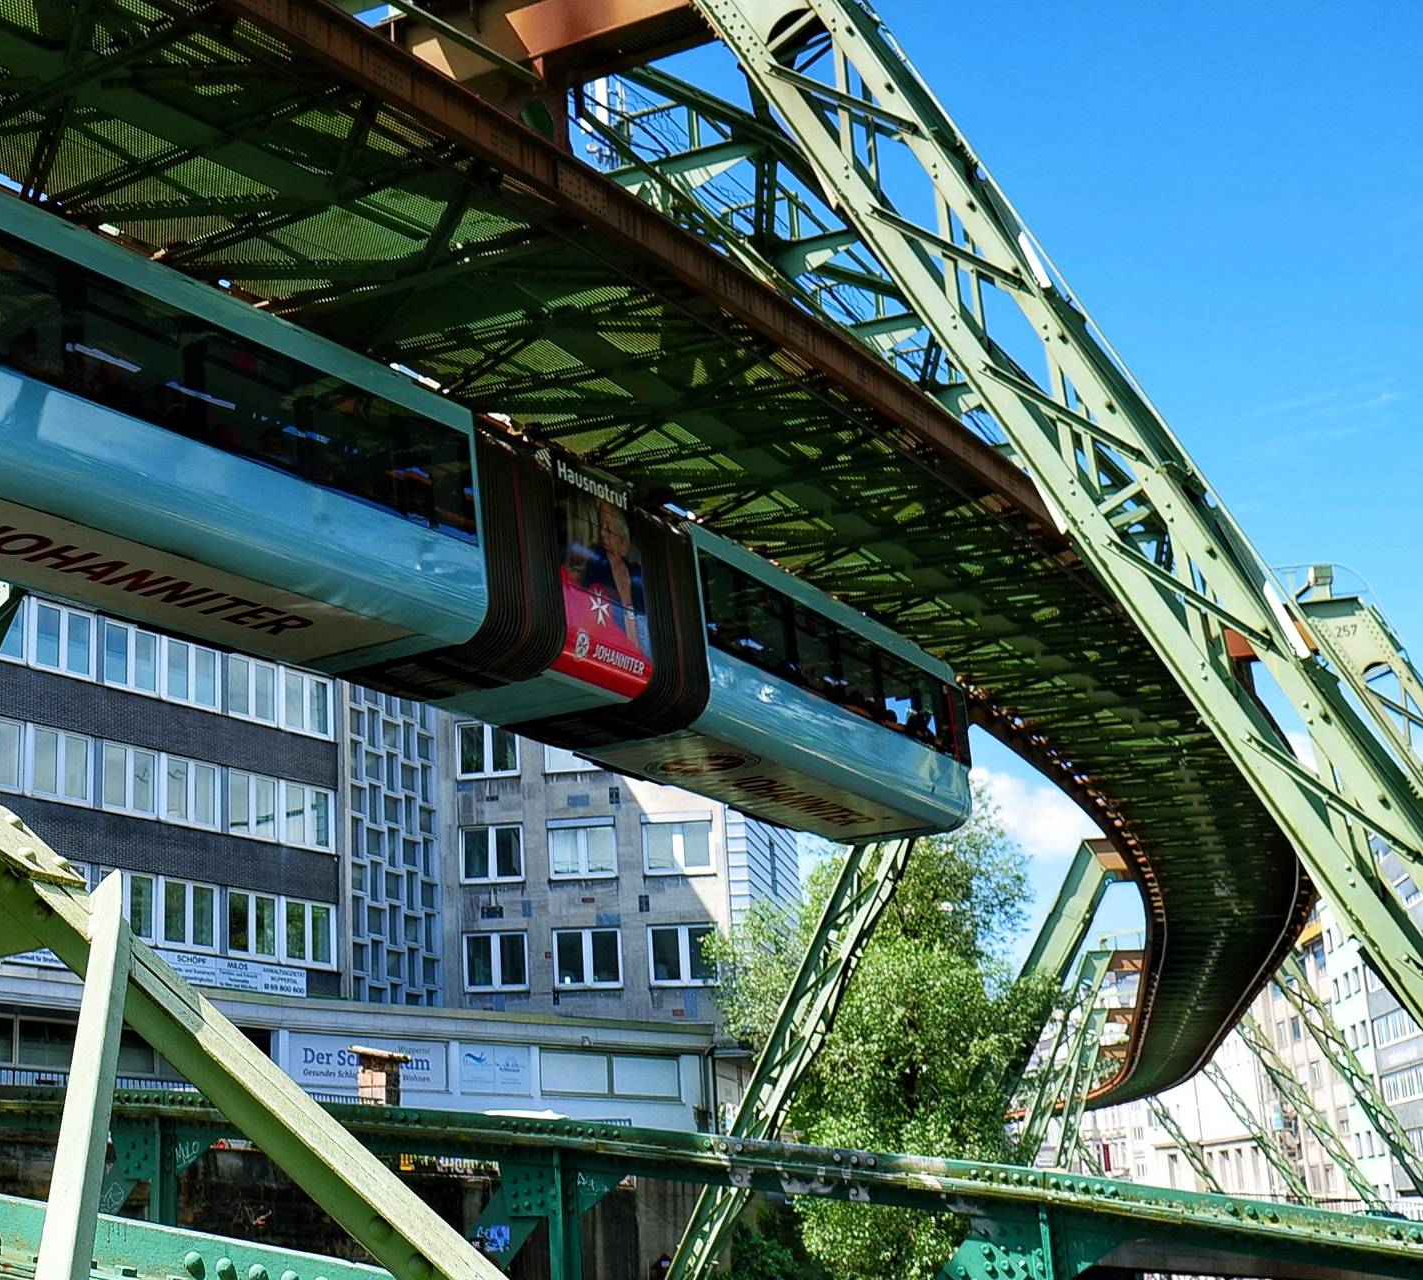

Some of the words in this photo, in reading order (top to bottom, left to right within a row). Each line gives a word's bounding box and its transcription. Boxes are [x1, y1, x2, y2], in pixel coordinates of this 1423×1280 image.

[557, 459, 628, 511] Hausnotruf
[1336, 624, 1357, 638] 257
[592, 643, 645, 676] JOHANNITER
[177, 955, 207, 965] SCHÖPF
[303, 1047, 333, 1065] Der
[303, 1068, 336, 1077] Gesundes
[402, 1074, 431, 1083] Wohnen
